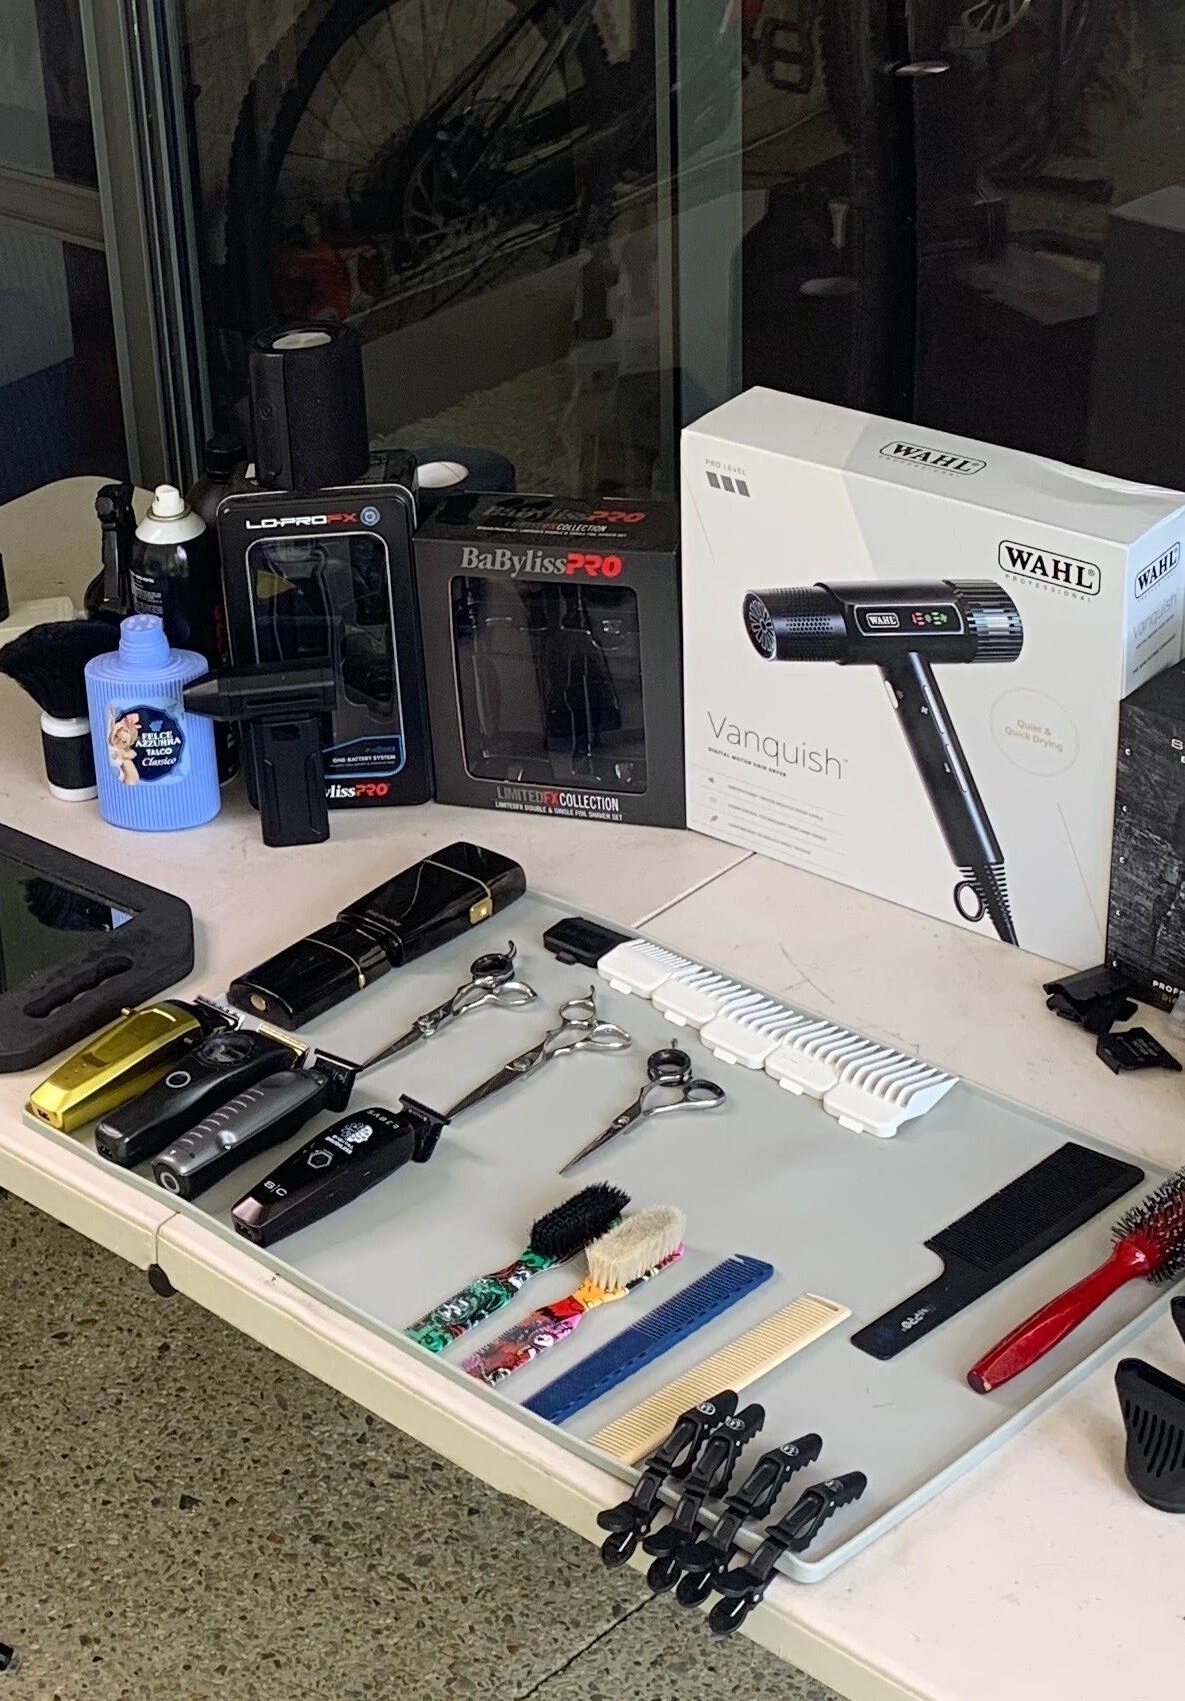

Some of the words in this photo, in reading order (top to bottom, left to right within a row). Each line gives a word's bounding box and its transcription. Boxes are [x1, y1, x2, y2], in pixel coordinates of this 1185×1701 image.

[893, 443, 972, 472] WAHL
[460, 547, 624, 578] BaBylissPRO
[1004, 545, 1094, 590] WAHL
[1137, 550, 1178, 591] WAHL
[1005, 573, 1092, 603] PROFESSIONAL
[868, 615, 897, 625] WAHL
[141, 730, 174, 741] FELCE
[1005, 726, 1030, 741] Quick
[1033, 735, 1064, 753] Drying
[1017, 719, 1042, 733] Quiet
[135, 736, 182, 748] AZZURRA
[146, 747, 173, 757] TALCO
[707, 711, 842, 780] Vanquish
[142, 756, 177, 767] Classico
